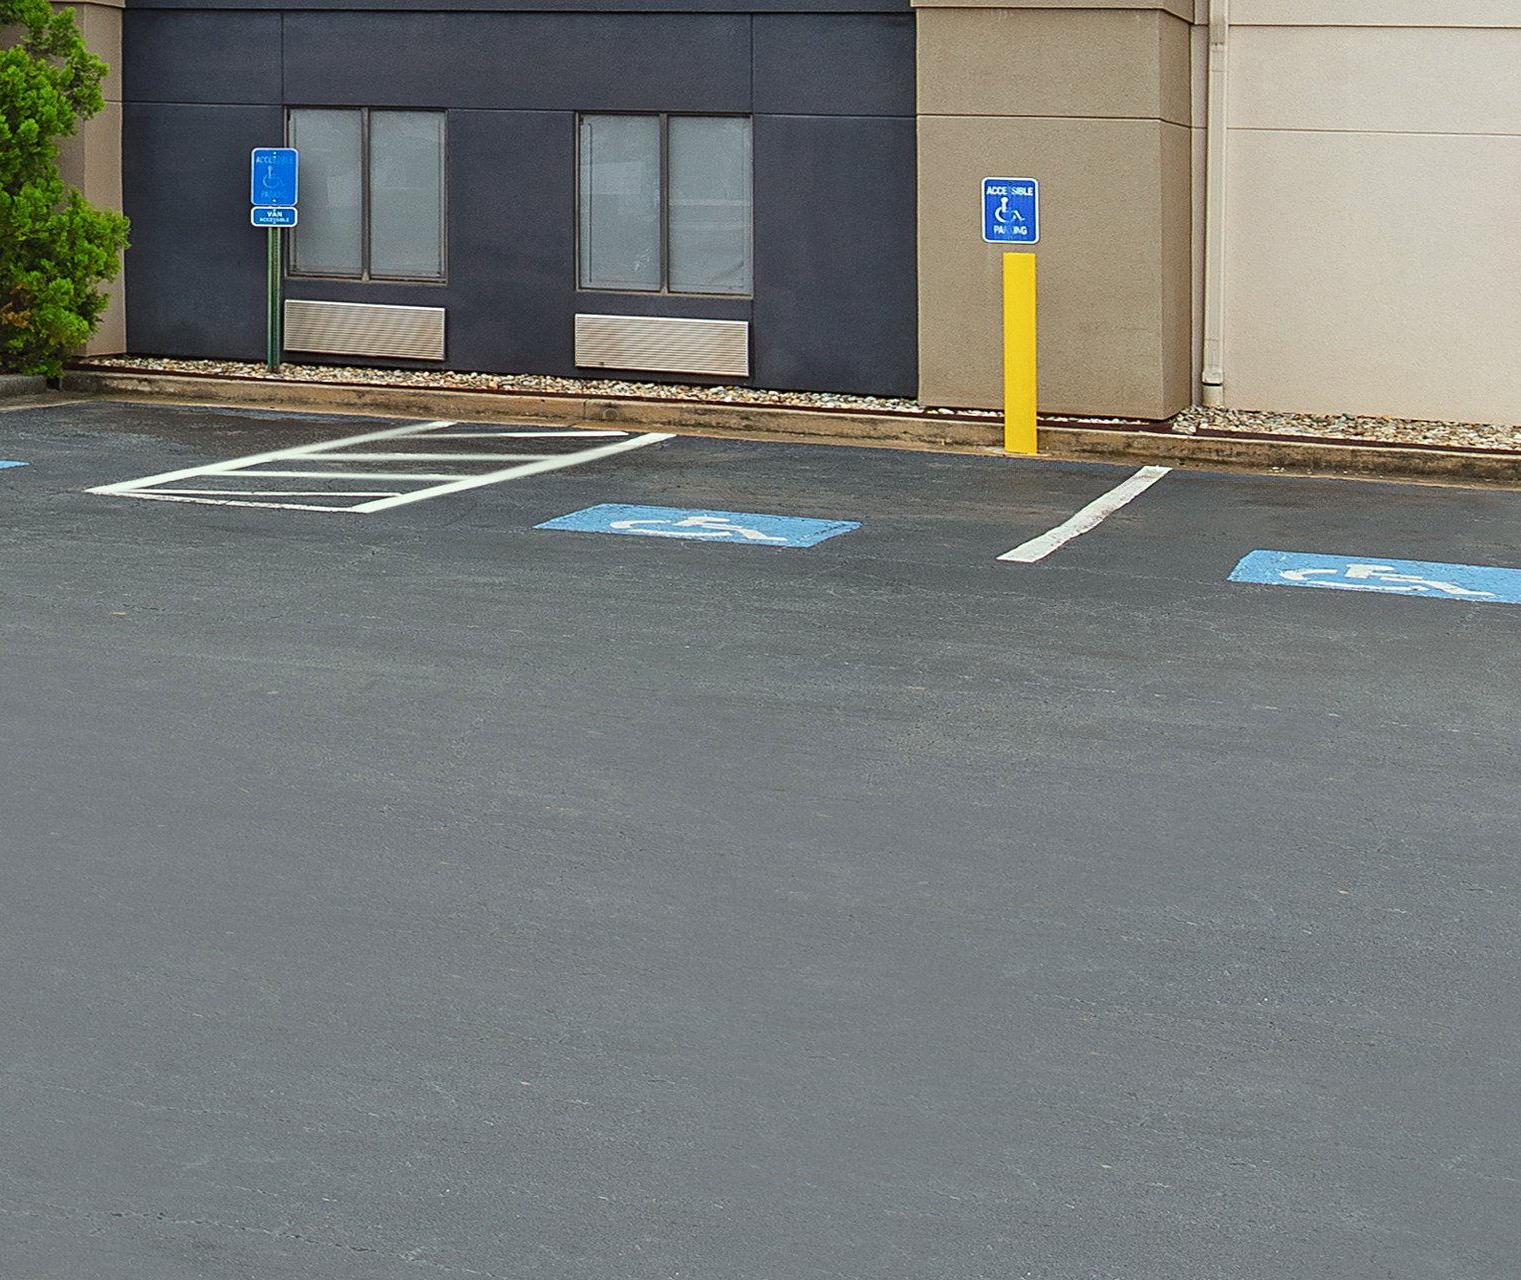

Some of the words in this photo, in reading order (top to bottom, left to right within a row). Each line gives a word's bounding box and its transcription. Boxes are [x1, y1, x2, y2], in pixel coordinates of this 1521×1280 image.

[986, 185, 1034, 197] ACCESIBLE
[266, 210, 283, 218] VAN
[993, 224, 1028, 236] PAING
